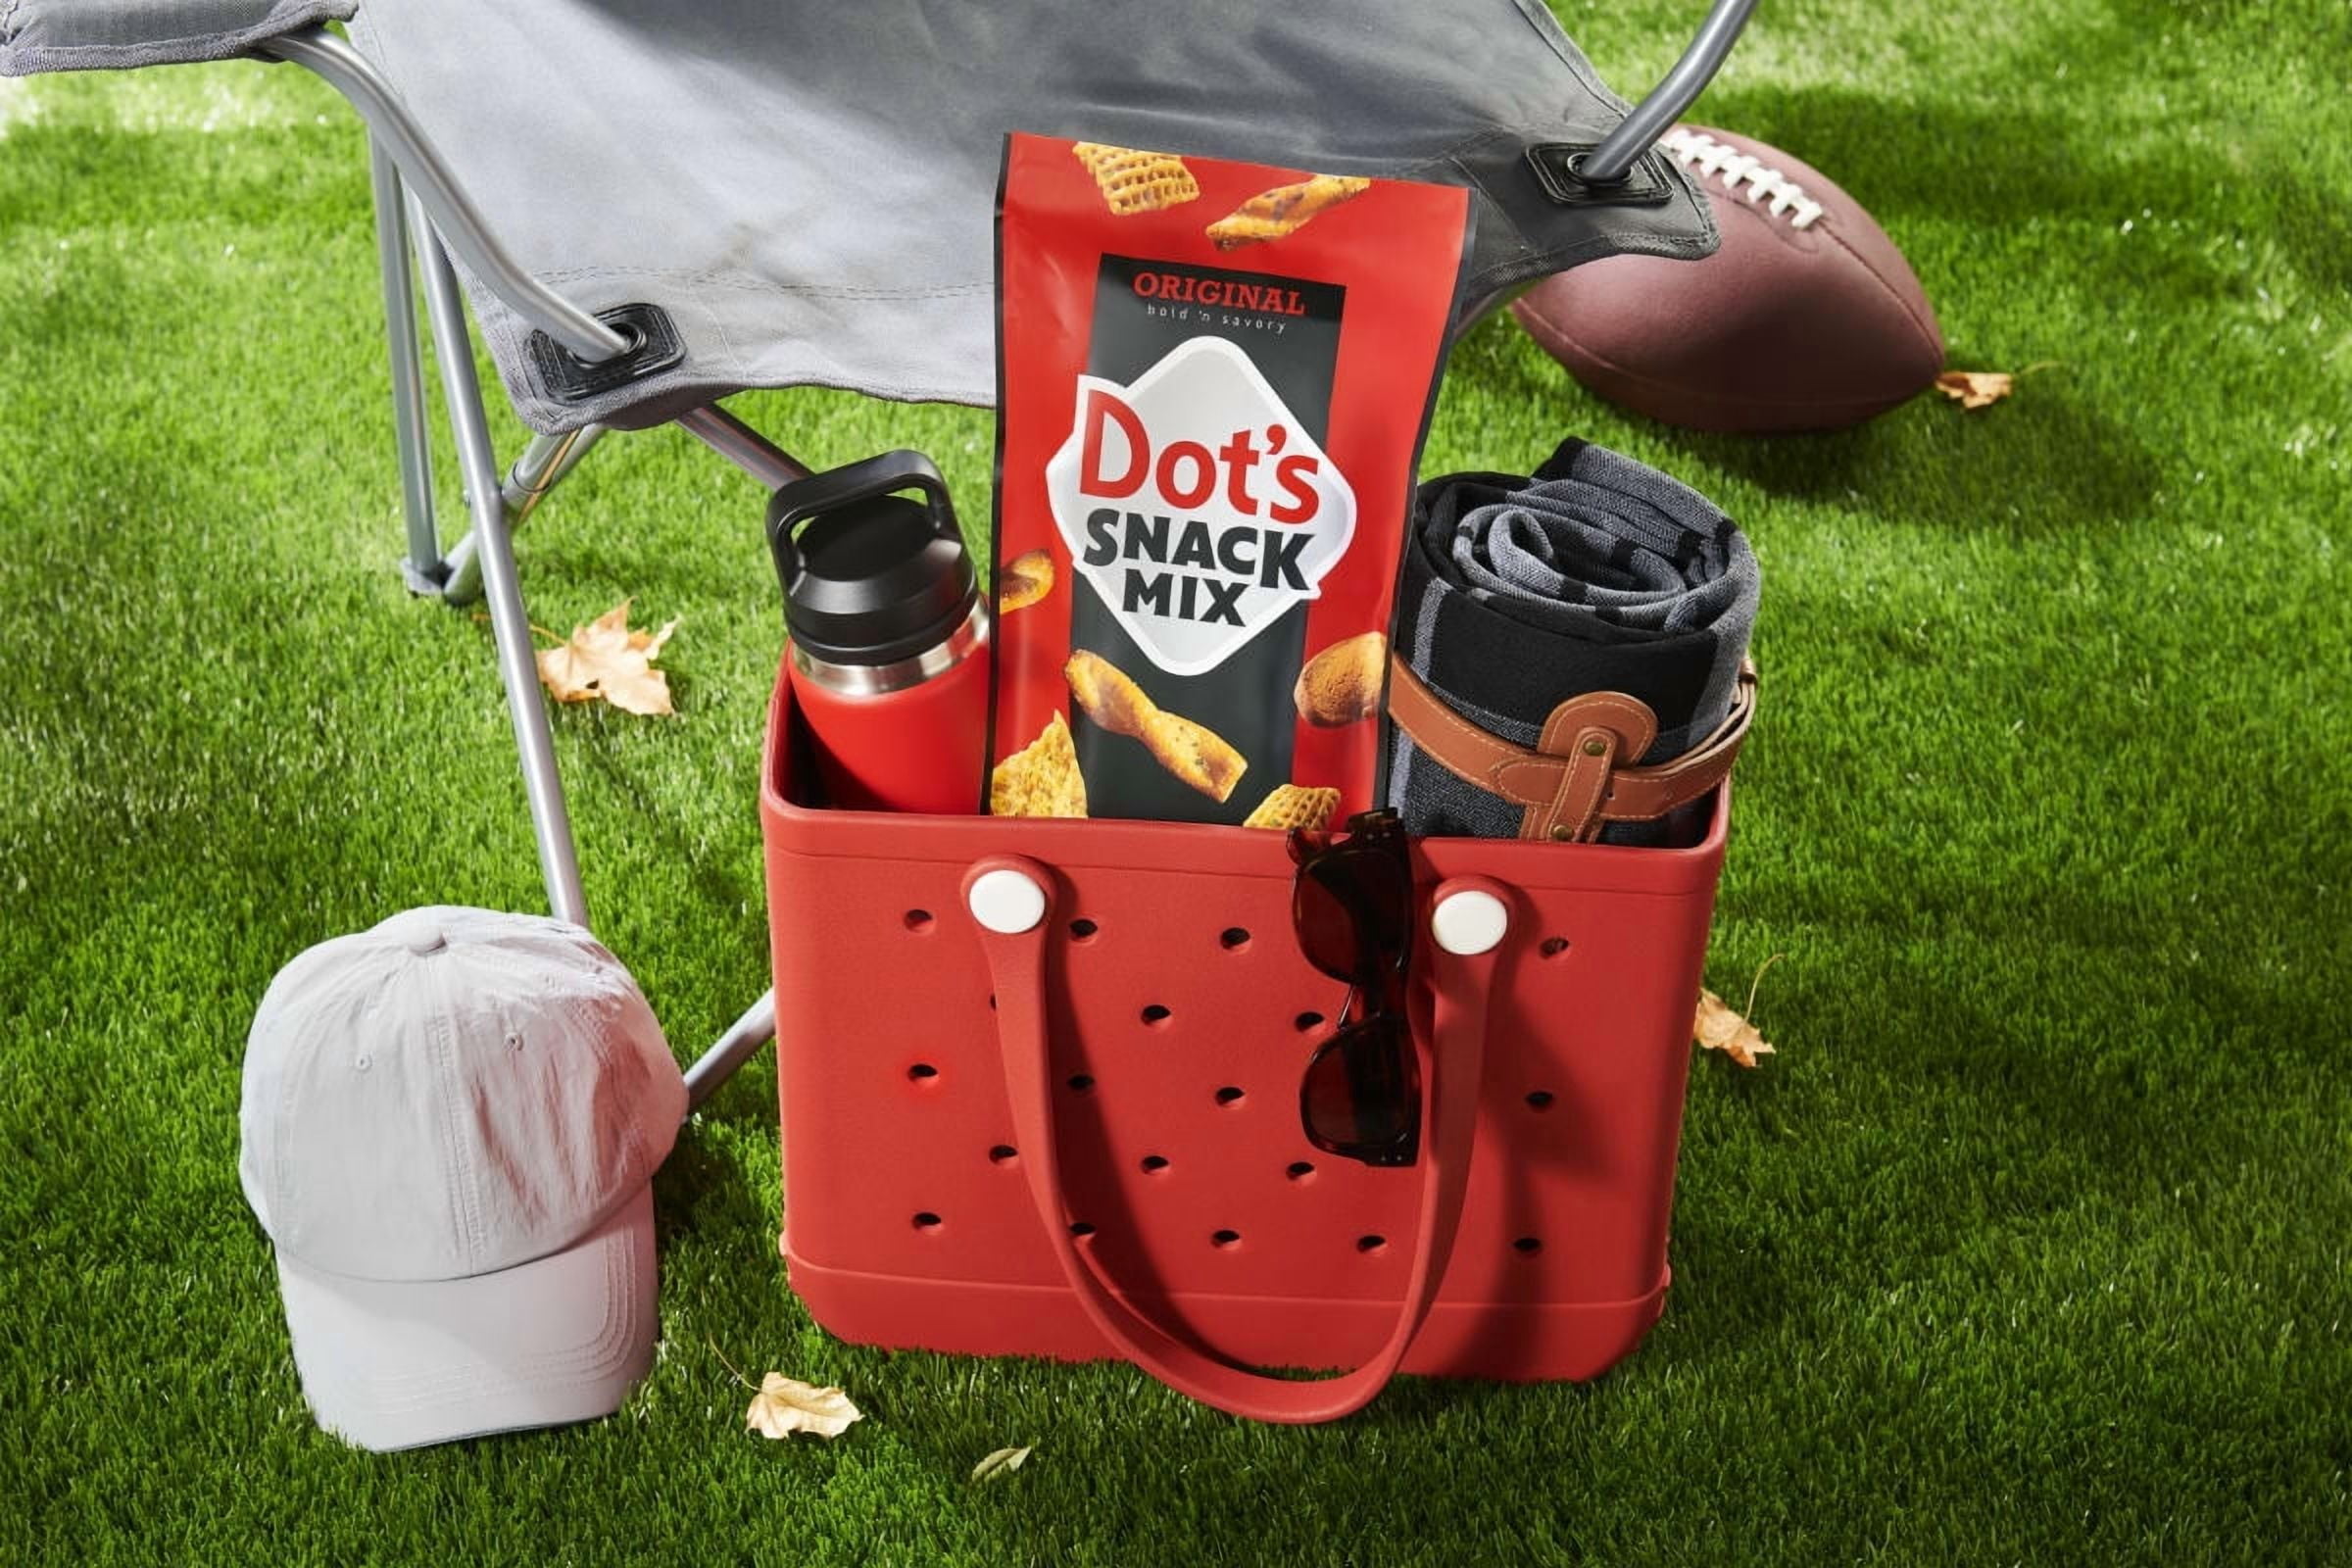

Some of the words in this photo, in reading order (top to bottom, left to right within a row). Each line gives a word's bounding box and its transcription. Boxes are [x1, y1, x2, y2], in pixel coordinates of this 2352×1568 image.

[1134, 272, 1305, 315] ORIGINAL
[1222, 315, 1286, 334] savory
[1080, 389, 1320, 524] Dot's
[1083, 508, 1316, 591] SNACK
[1123, 568, 1250, 627] MIX
